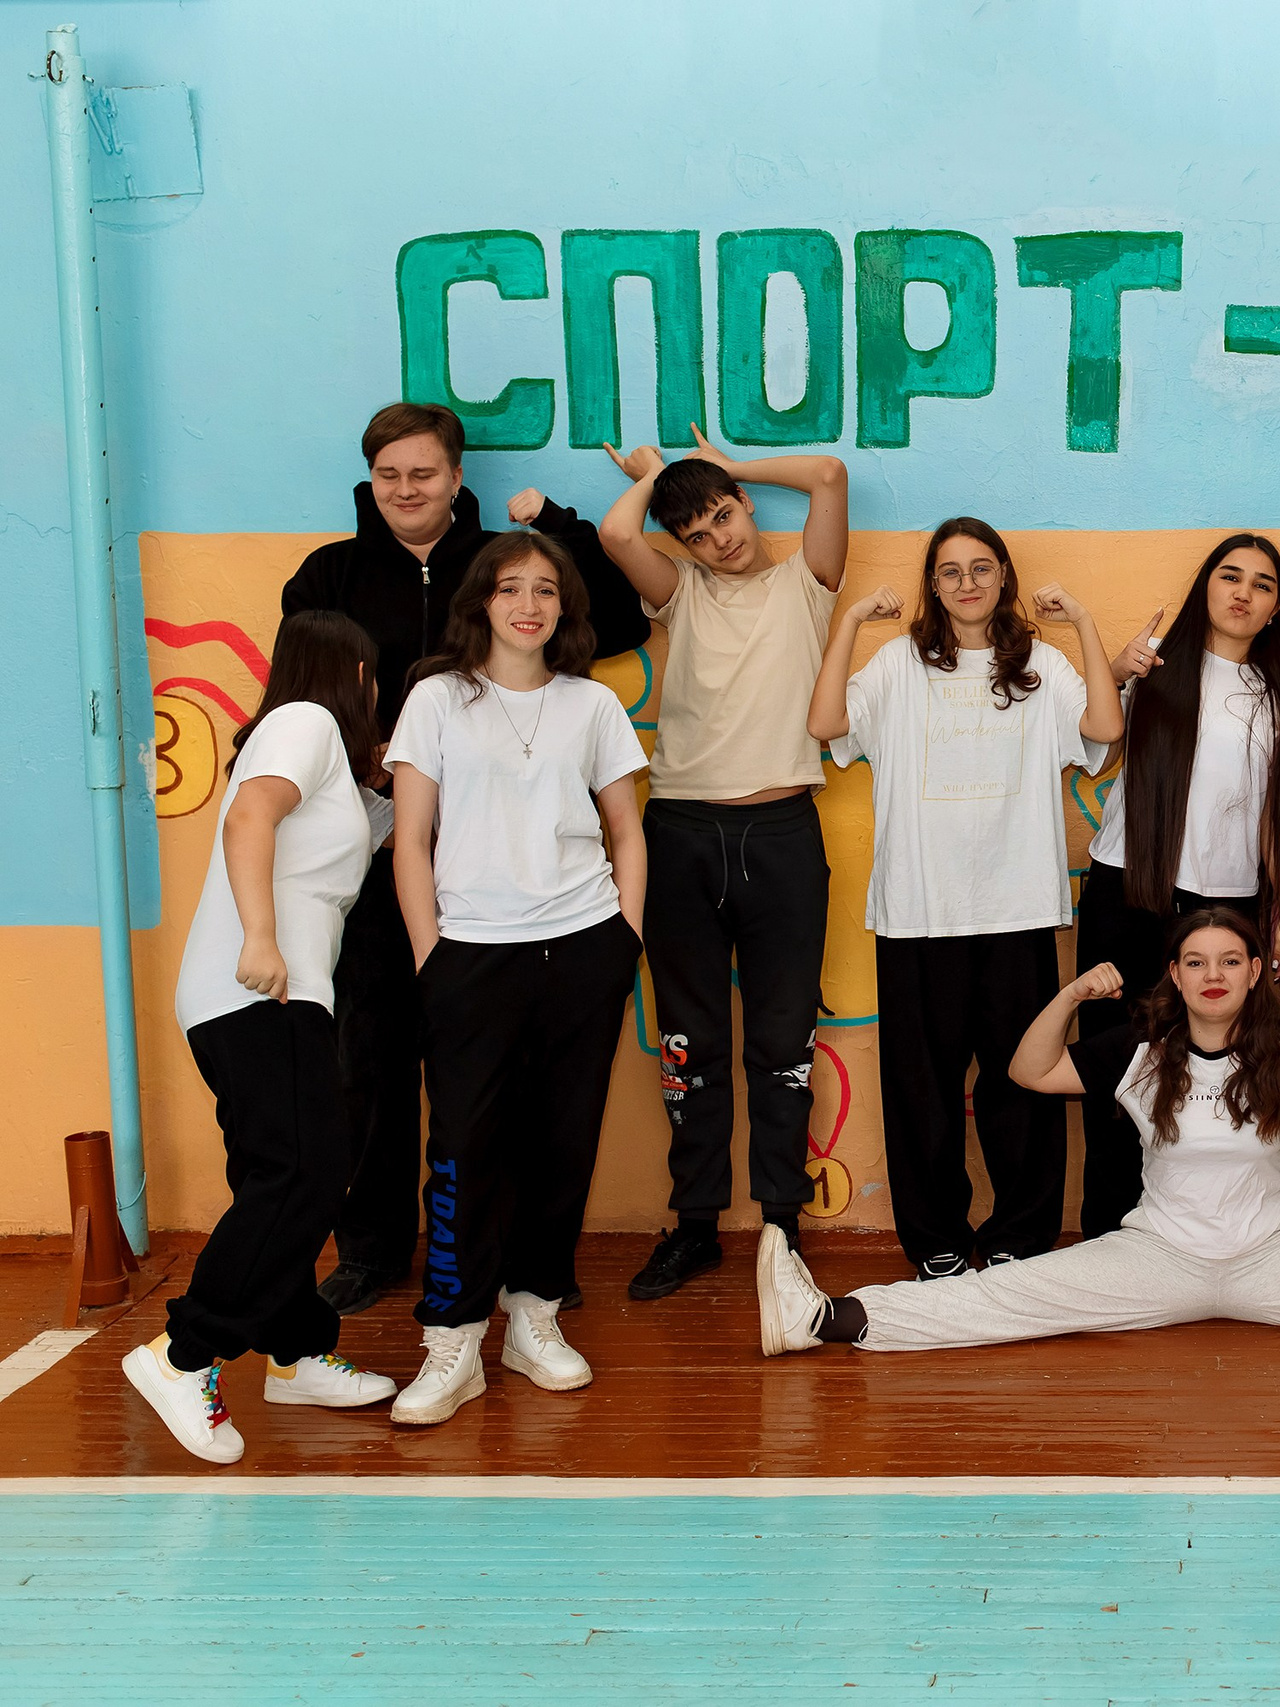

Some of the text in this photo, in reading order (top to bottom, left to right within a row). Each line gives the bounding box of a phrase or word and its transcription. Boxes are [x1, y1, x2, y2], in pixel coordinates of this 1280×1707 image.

[396, 229, 1183, 453] СПОРТ
[930, 711, 1020, 744] Wonderful
[943, 781, 1006, 793] WILL HAPPEN
[812, 1166, 830, 1209] 1
[425, 1159, 463, 1312] T'DANCE
